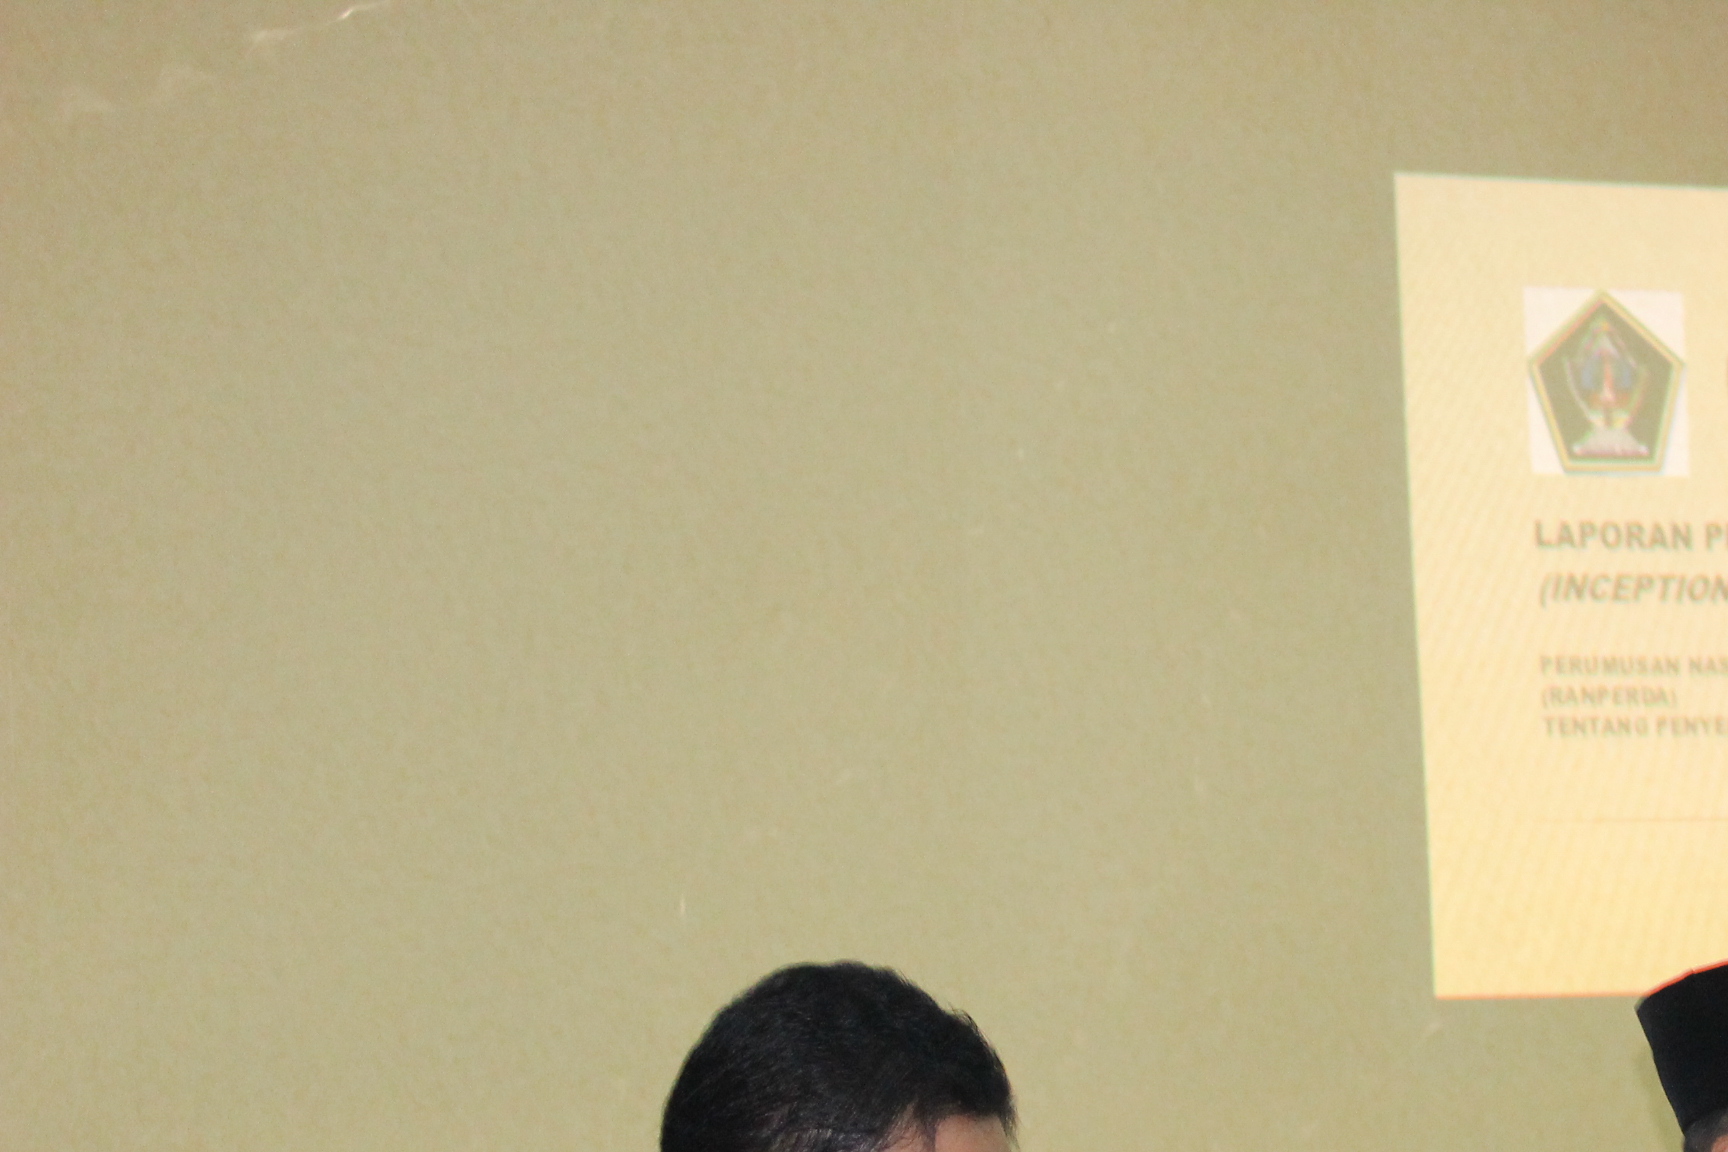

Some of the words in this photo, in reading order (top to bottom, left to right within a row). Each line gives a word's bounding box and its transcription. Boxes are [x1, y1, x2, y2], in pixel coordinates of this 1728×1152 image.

[1534, 521, 1694, 550] LAPORAN
[1540, 655, 1681, 676] PERUMUSAN
[1541, 684, 1678, 709] (RANPERDA)
[1543, 715, 1649, 738] TENTANG
